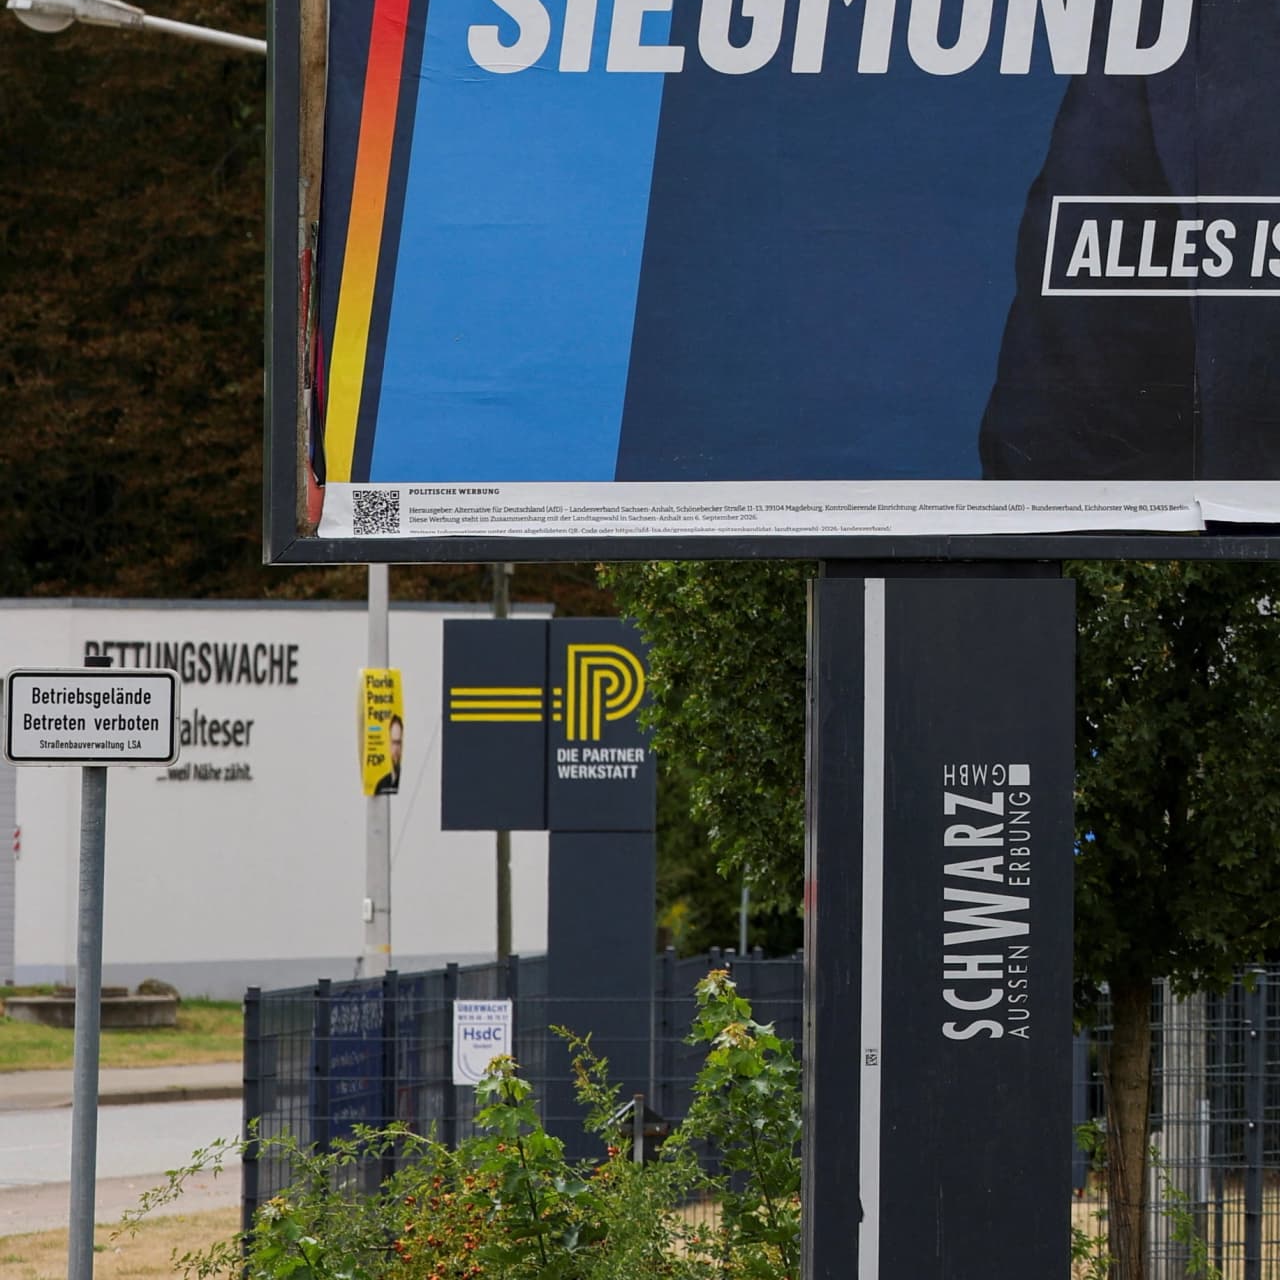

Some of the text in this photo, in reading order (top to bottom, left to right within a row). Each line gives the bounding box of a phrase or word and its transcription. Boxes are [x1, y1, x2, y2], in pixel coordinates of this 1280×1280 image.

[1065, 219, 1236, 279] ALLES
[455, 505, 491, 513] Alternative
[492, 505, 502, 513] für
[504, 505, 545, 513] Deutschland
[546, 504, 563, 513] (AfD)
[570, 504, 619, 513] Landesverband
[676, 503, 722, 513] Schönebecker
[724, 503, 745, 512] Straße
[765, 504, 784, 512] 39104
[825, 503, 876, 512] Kontrollierende
[919, 503, 955, 511] Alternative
[956, 503, 966, 511] für
[967, 503, 1007, 511] Deutschland
[1008, 503, 1025, 512] (AfD)
[1031, 503, 1083, 512] Bundesverband,
[1084, 503, 1122, 512] Eichhorster
[1123, 504, 1138, 513] Weg
[1149, 504, 1168, 512] 13435
[429, 515, 460, 524] Werbung
[491, 514, 545, 524] Zusammenhang
[560, 513, 571, 521] der
[572, 513, 619, 523] Landtagswahl
[628, 513, 682, 521] Sachsen-Anhalt
[702, 513, 739, 523] September
[508, 526, 523, 534] dem
[31, 687, 152, 709] Betriebsgelände
[23, 713, 159, 731] Betreten verboten
[39, 739, 142, 751] Straßenbauverwaltung LSA
[557, 748, 645, 762] DIE PARTNER
[557, 765, 638, 779] WERKSTATT
[944, 763, 1006, 786] GMBH
[942, 791, 1030, 1040] SCHWARZ
[1008, 945, 1030, 1039] AUSSEN
[463, 1027, 502, 1041] HsdC
